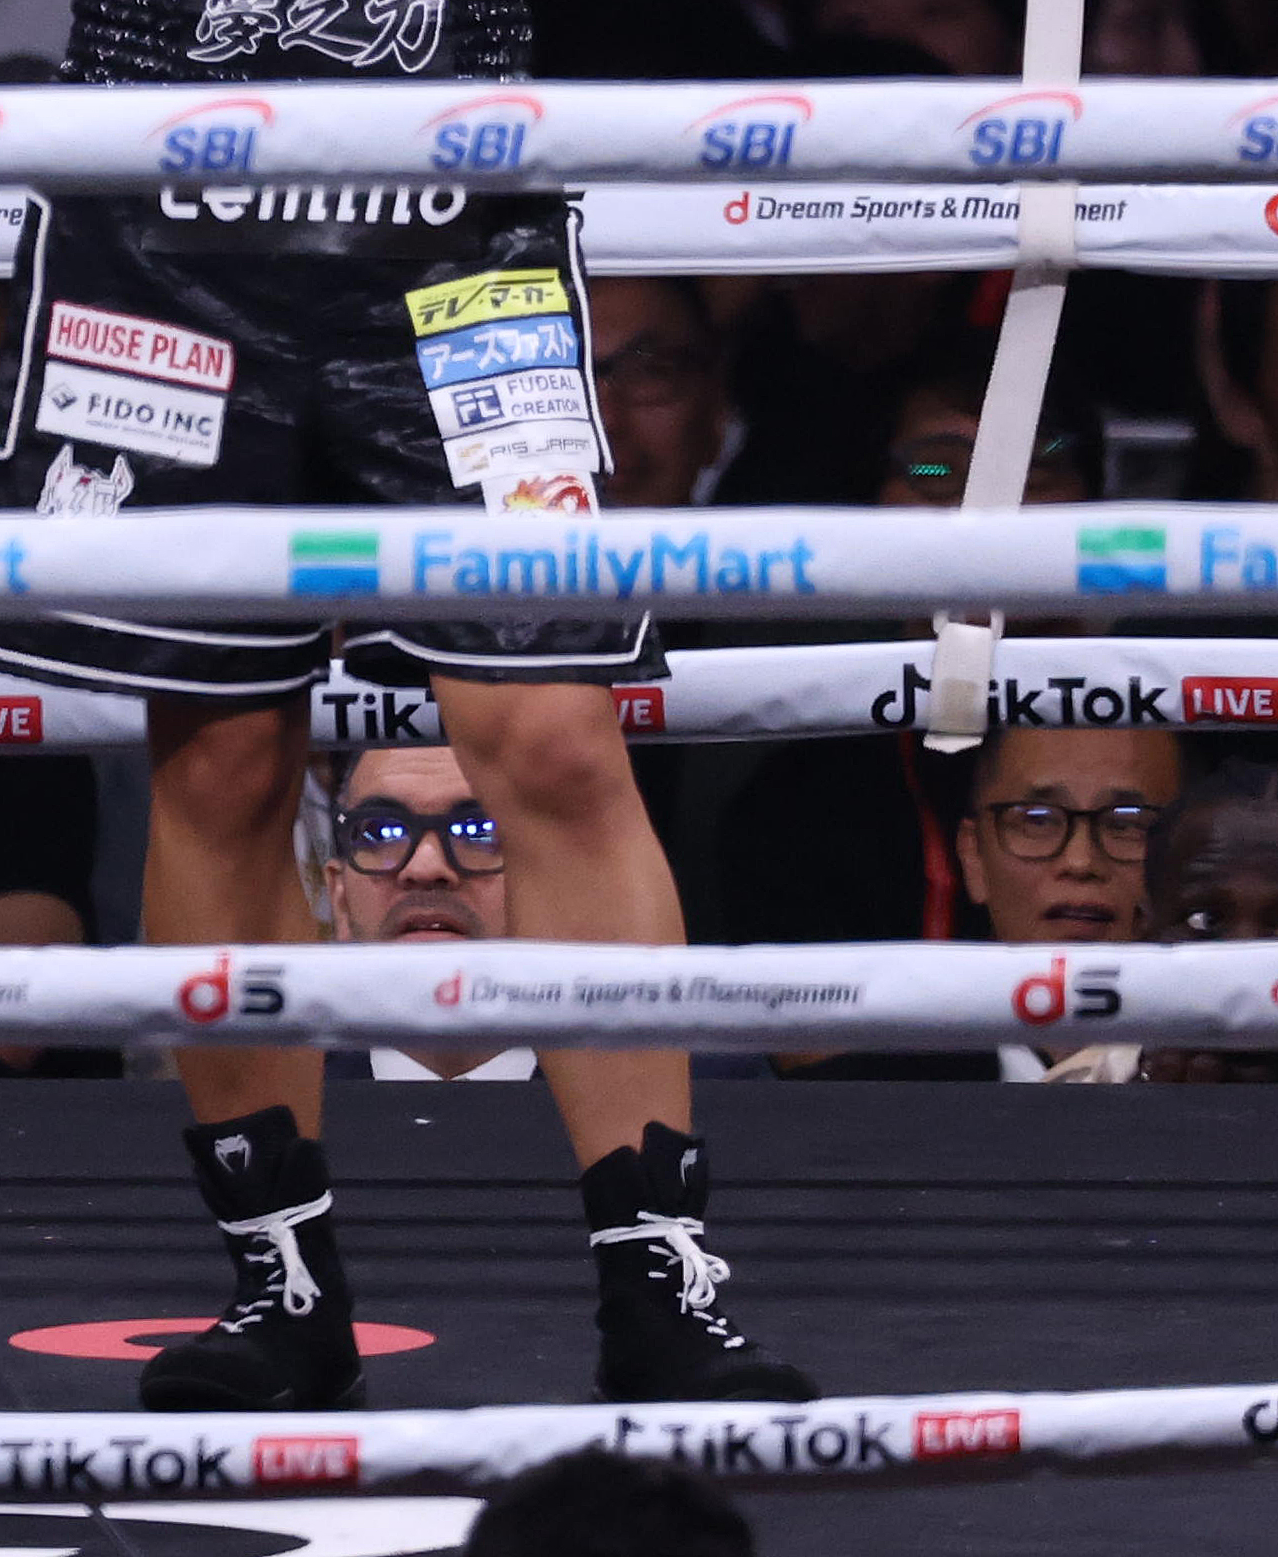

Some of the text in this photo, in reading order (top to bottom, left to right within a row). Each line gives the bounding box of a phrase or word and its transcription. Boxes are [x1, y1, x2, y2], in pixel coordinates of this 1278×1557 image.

[159, 124, 258, 174] SBI
[430, 122, 529, 171] SBI
[698, 120, 797, 168] SBI
[970, 117, 1067, 166] SBI
[755, 197, 844, 221] Dream
[850, 196, 936, 225] Sports
[941, 197, 957, 221] &
[56, 314, 225, 378] HOUSE PLAN
[507, 374, 577, 395] FUDEAL
[511, 398, 581, 418] CREATION
[87, 393, 155, 425] FIDO
[162, 408, 215, 438] INC
[410, 528, 817, 599] FamilyMart
[988, 676, 1274, 727] ikTok LIVE
[661, 1412, 901, 1474] TikTok
